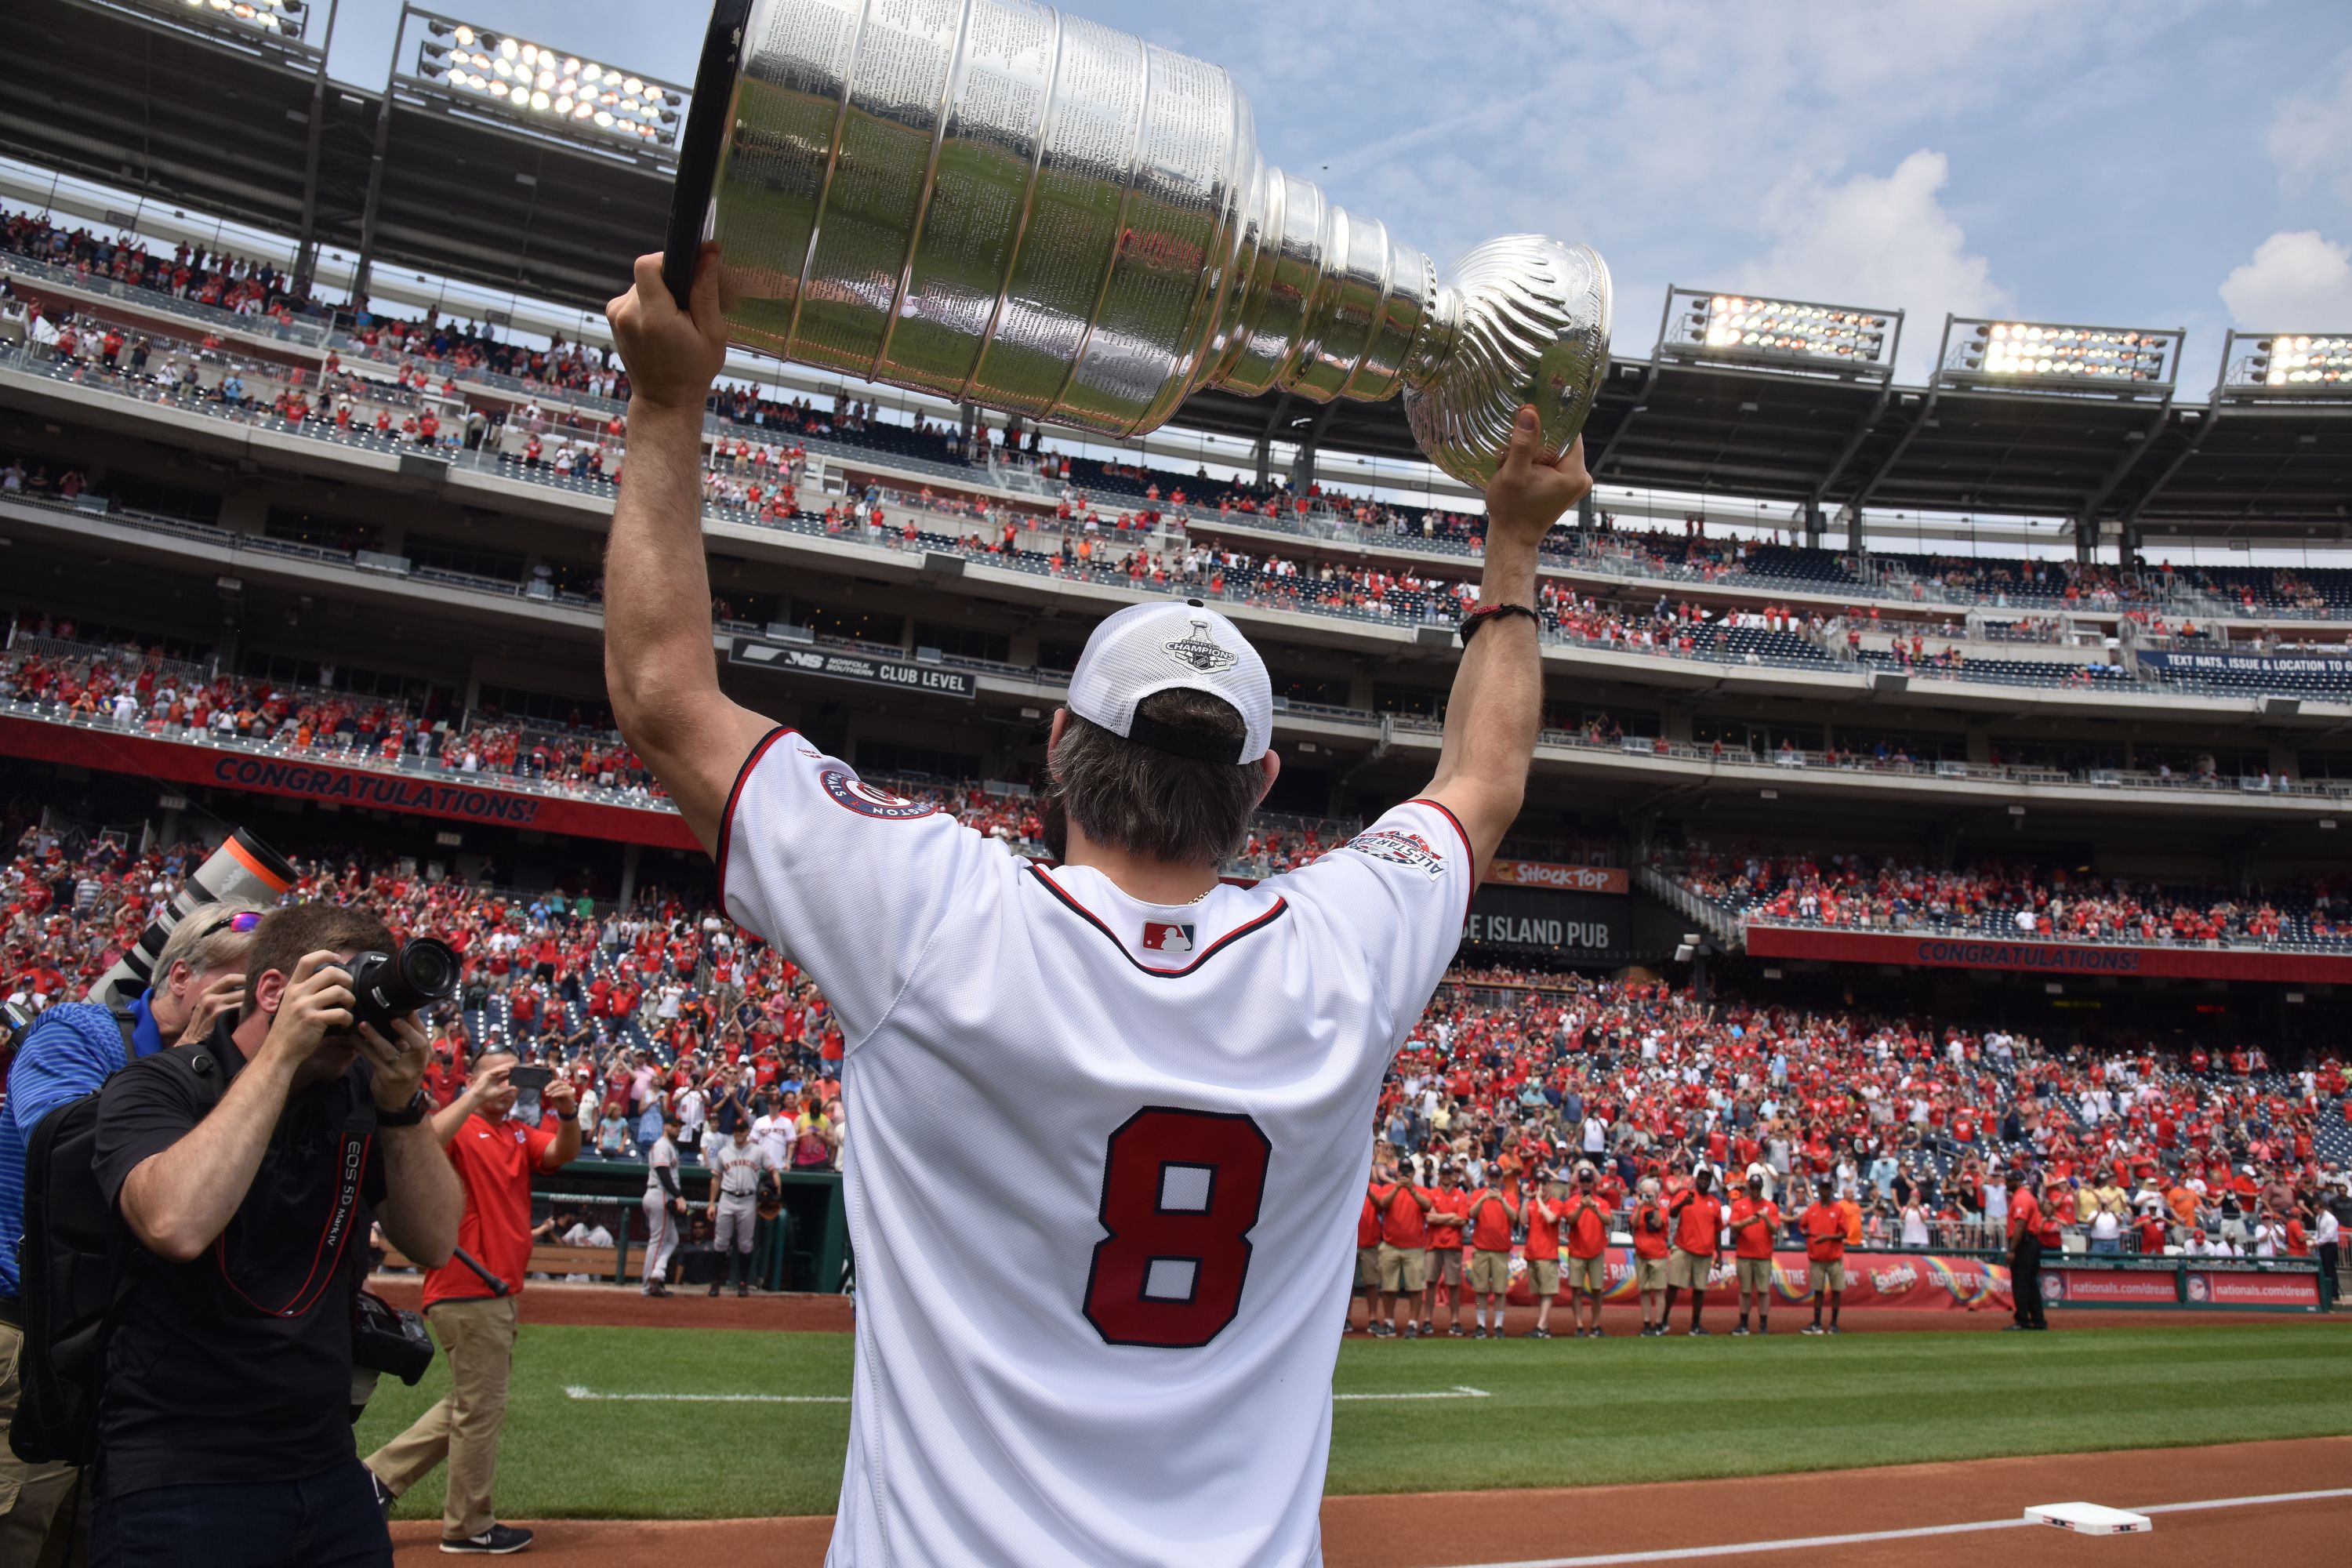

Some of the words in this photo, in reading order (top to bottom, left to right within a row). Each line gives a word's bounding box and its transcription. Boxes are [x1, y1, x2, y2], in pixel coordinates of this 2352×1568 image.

[1166, 643, 1234, 660] CHAMPIONS
[826, 664, 874, 677] SOUTHERN
[828, 657, 871, 669] NORFOLK
[2167, 654, 2194, 666] TEXT
[2196, 655, 2227, 669] NATS,
[2229, 658, 2259, 670] ISSUE
[2262, 659, 2271, 670] &
[2274, 659, 2325, 672] LOCATION
[2328, 660, 2342, 672] TO
[880, 665, 918, 684] CLUB
[922, 672, 966, 691] LEVEL
[213, 756, 539, 823] CONGRATULATIONS!
[1517, 865, 1572, 884] SHOCK
[1573, 868, 1609, 887] TOP
[1487, 915, 1562, 946] ISLAND
[1568, 922, 1609, 948] PUB
[1918, 942, 2140, 971] CONGRATULATIONS!
[343, 1141, 361, 1181] EOS
[341, 1185, 355, 1206] 5D
[549, 1192, 618, 1204] nationals.com
[332, 1207, 345, 1237] Mark
[1082, 1105, 1272, 1349] 8
[327, 1234, 336, 1247] IV
[2072, 1281, 2176, 1295] nationals.com/dream
[2216, 1283, 2315, 1298] nationals.com/dream
